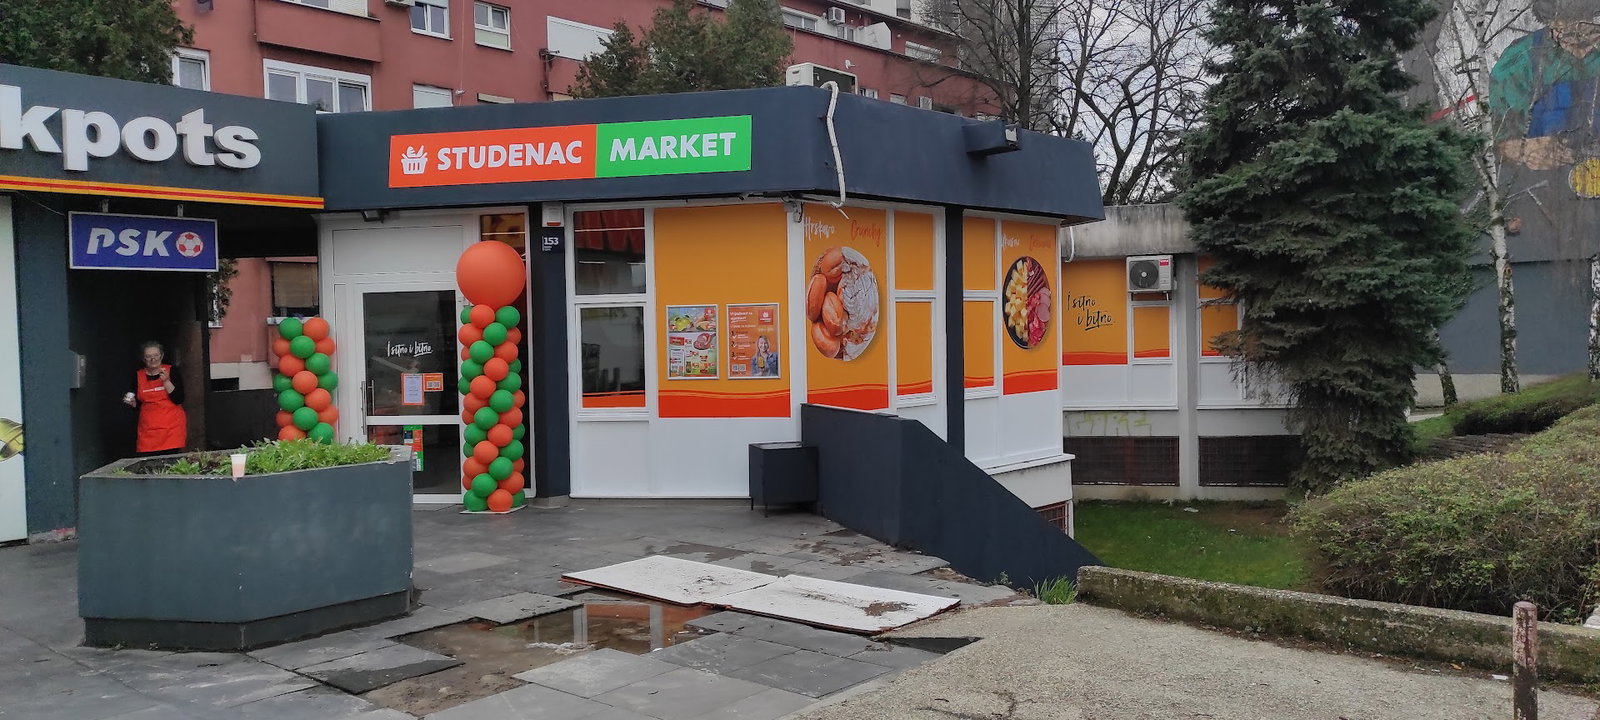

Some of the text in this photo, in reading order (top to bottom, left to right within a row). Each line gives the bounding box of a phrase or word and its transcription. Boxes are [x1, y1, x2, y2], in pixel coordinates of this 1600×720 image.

[0, 84, 262, 172] kpots
[437, 132, 737, 171] STUDENAC MARKET
[86, 227, 174, 258] PSK
[543, 236, 559, 246] 153
